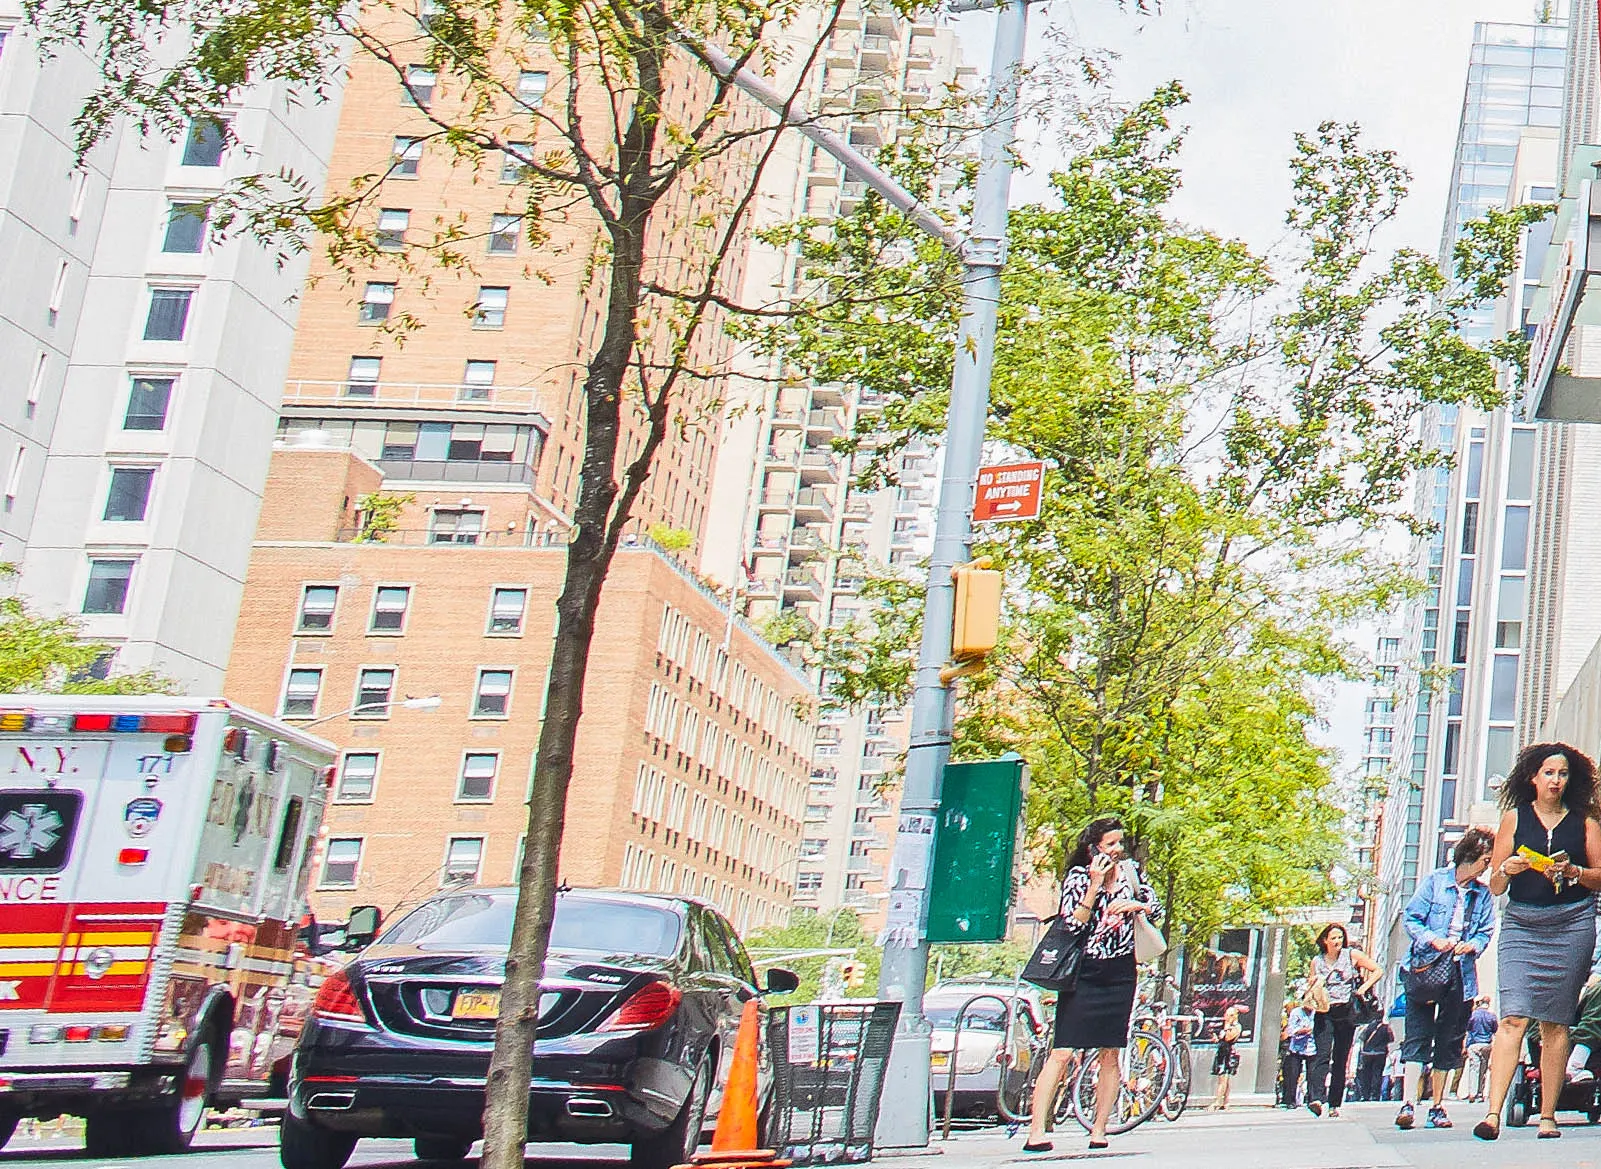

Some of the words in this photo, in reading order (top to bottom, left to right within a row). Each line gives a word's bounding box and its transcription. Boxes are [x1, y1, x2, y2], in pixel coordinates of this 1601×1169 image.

[980, 473, 993, 485] NO
[996, 468, 1040, 484] STANDING
[984, 484, 1031, 500] ANYTIME
[136, 755, 174, 773] 171
